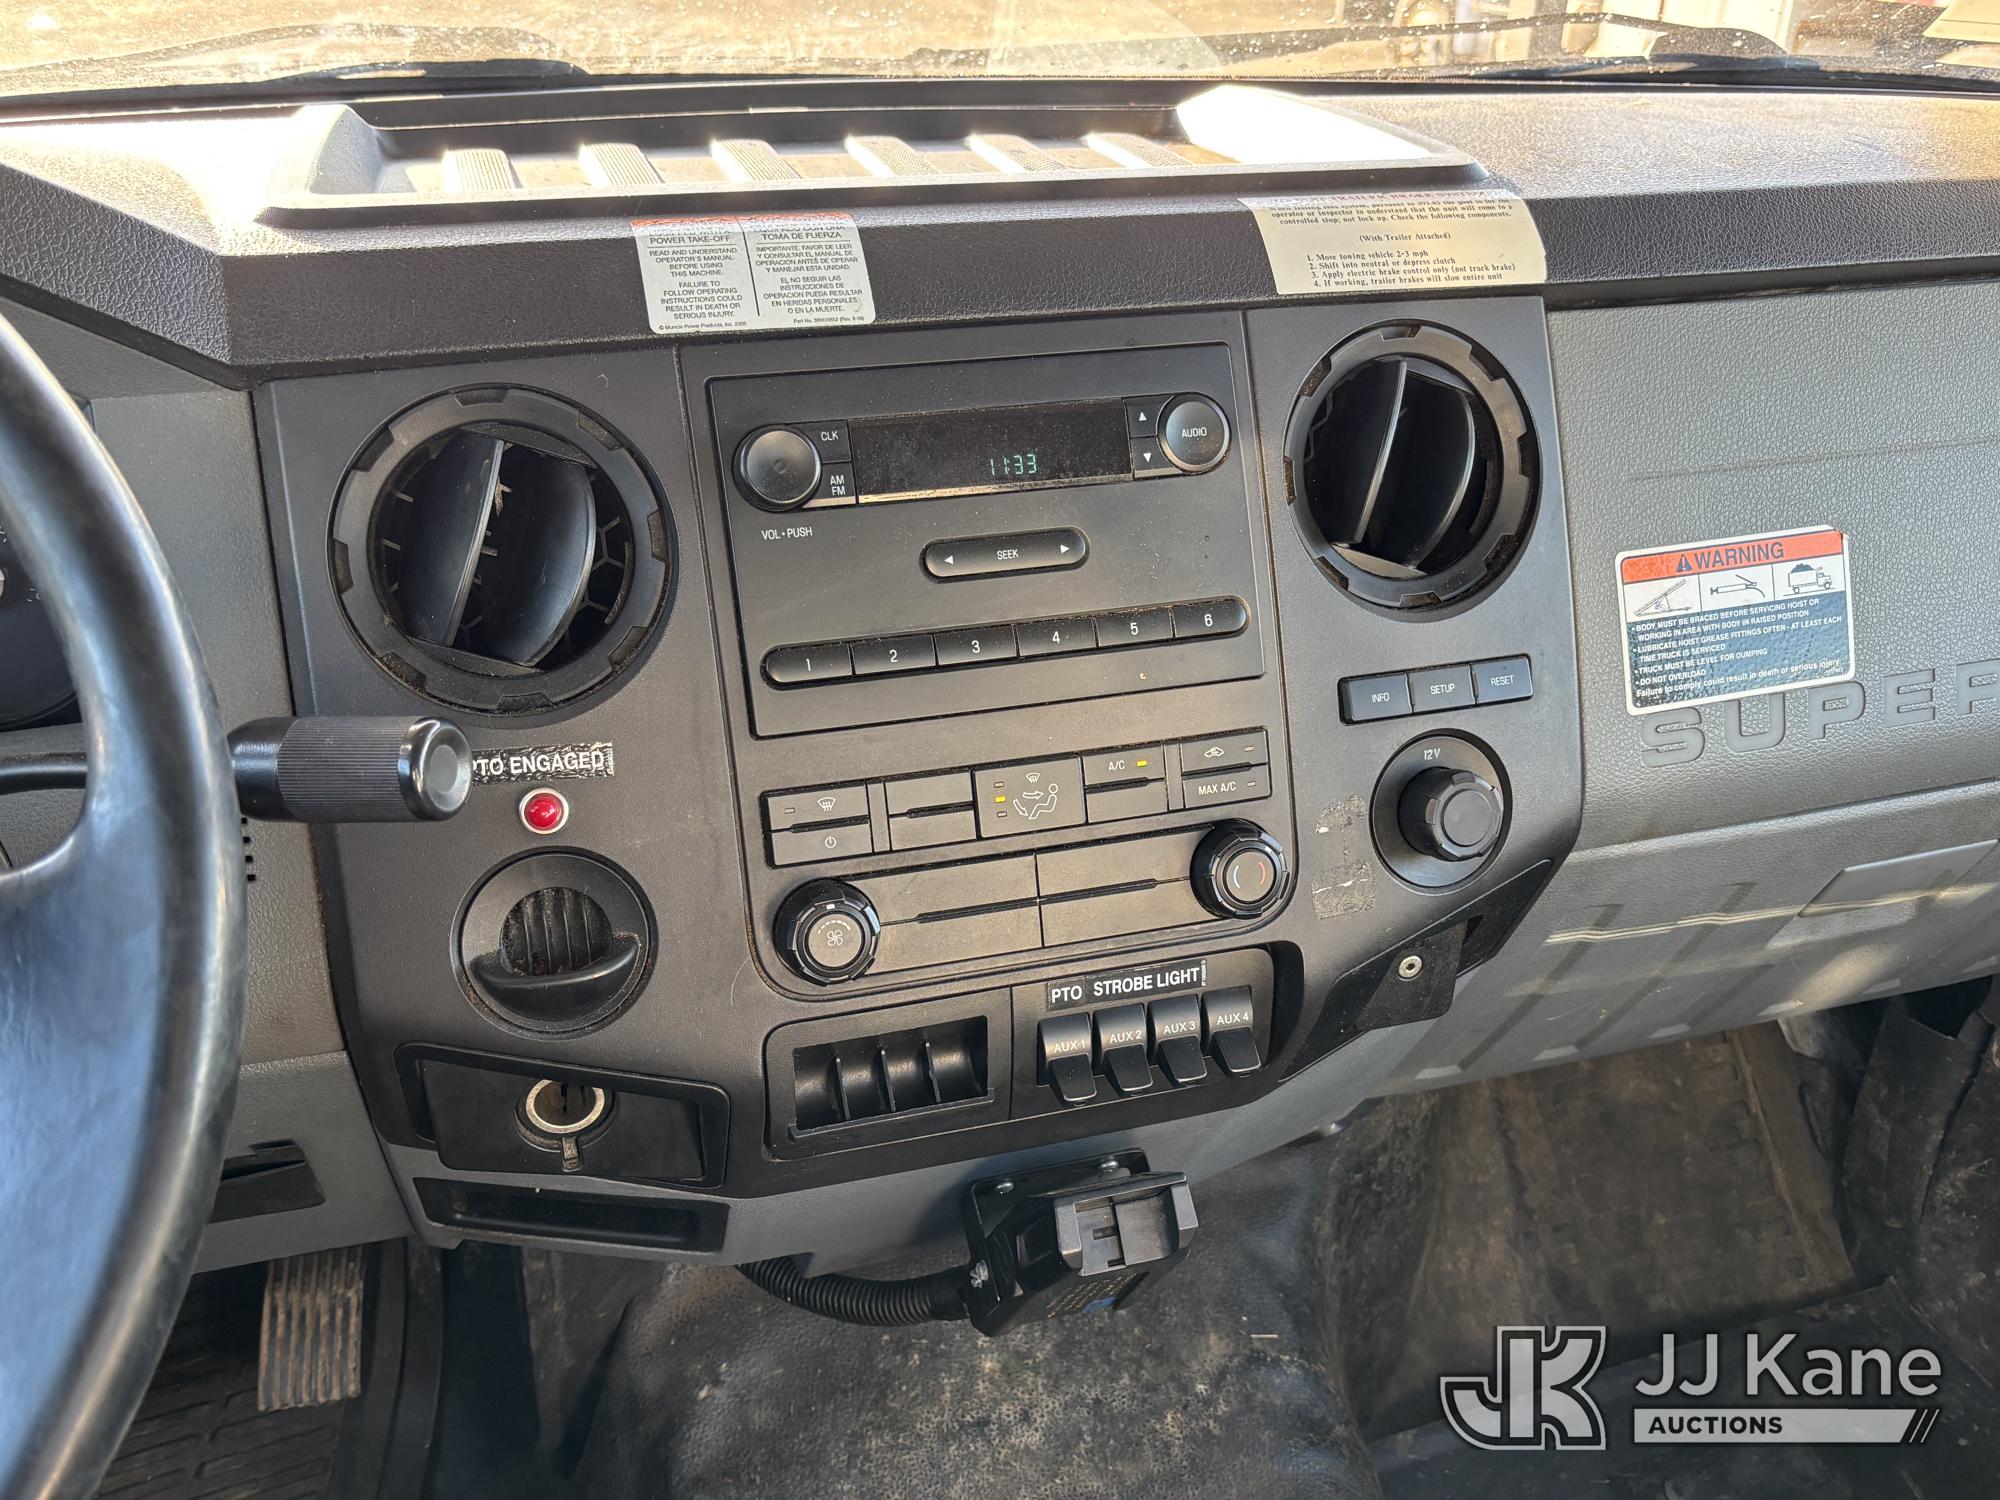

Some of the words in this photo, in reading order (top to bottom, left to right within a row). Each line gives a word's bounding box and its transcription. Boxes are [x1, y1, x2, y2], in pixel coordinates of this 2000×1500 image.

[649, 236, 685, 244] POWER
[687, 235, 731, 243] TAKE-OFF
[1359, 233, 1382, 243] (With
[821, 431, 838, 442] CLK
[1182, 427, 1208, 438] AUDIO
[989, 453, 1038, 476] 11:33
[830, 475, 845, 486] AM
[832, 486, 846, 496] FM
[997, 549, 1018, 560] SEEK
[1694, 542, 1784, 570] WARNING
[1204, 614, 1213, 627] 6
[1636, 622, 1655, 632] BODY
[1656, 619, 1676, 629] MUST
[1678, 618, 1688, 626] BE
[1689, 613, 1718, 624] BRACED
[1719, 609, 1747, 619] BEFORE
[1749, 603, 1785, 615] SERVICING
[1786, 600, 1806, 609] HOIST
[1808, 598, 1819, 606] OR
[1130, 623, 1138, 636] 5
[1638, 630, 1671, 641] WORKING
[1682, 625, 1701, 634] AREA
[1702, 622, 1720, 632] WITH
[1721, 620, 1739, 629] BODY
[1750, 614, 1775, 625] RAISED
[1777, 610, 1809, 621] POSITION
[1052, 632, 1060, 644] 4
[1638, 640, 1676, 653] LUBRICATE
[1678, 637, 1698, 647] HOIST
[1700, 632, 1728, 643] GREASE
[1730, 628, 1761, 639] FITTINGS
[1762, 624, 1785, 634] OFTEN
[1800, 618, 1821, 628] LEAST
[1823, 615, 1841, 625] EACH
[971, 640, 981, 654] 3
[1639, 653, 1655, 662] TIME
[1657, 650, 1680, 660] TRUCK
[1690, 644, 1726, 655] SERVICED
[889, 650, 898, 663] 2
[1638, 664, 1662, 674] TRUCK
[1664, 661, 1683, 670] MUST
[1696, 656, 1717, 665] LEVEL
[1719, 653, 1734, 662] FOR
[1735, 648, 1767, 659] DUMPING
[806, 658, 811, 671] 1
[1490, 674, 1514, 686] RESET
[1636, 685, 1662, 697] Failure
[1664, 684, 1672, 693] to
[1673, 679, 1701, 693] comply
[1702, 676, 1724, 687] could
[1726, 672, 1747, 683] result
[1748, 671, 1756, 680] in
[1757, 668, 1779, 678] death
[1790, 662, 1817, 674] serious
[1640, 677, 1650, 685] DO
[1651, 675, 1666, 684] NOT
[1668, 669, 1706, 681] OVERLOAD
[1430, 683, 1456, 695] SETUP
[1372, 692, 1390, 703] INFO
[1423, 748, 1441, 760] 12V
[510, 751, 605, 774] ENGAGED
[1108, 759, 1126, 772] A/C
[1198, 783, 1218, 795] MAX
[1220, 781, 1236, 793] A/C
[1094, 974, 1153, 996] STROBE
[1156, 967, 1200, 988] LIGHT
[1052, 985, 1083, 1004] PTO
[1216, 1014, 1241, 1026] AUX
[1242, 1012, 1250, 1022] 4
[1163, 1023, 1188, 1034] AUX
[1188, 1020, 1196, 1030] 3
[1109, 1032, 1134, 1044] AUX
[1134, 1030, 1142, 1039] 2
[1053, 1042, 1079, 1054] AUX
[1080, 1040, 1086, 1049] 1
